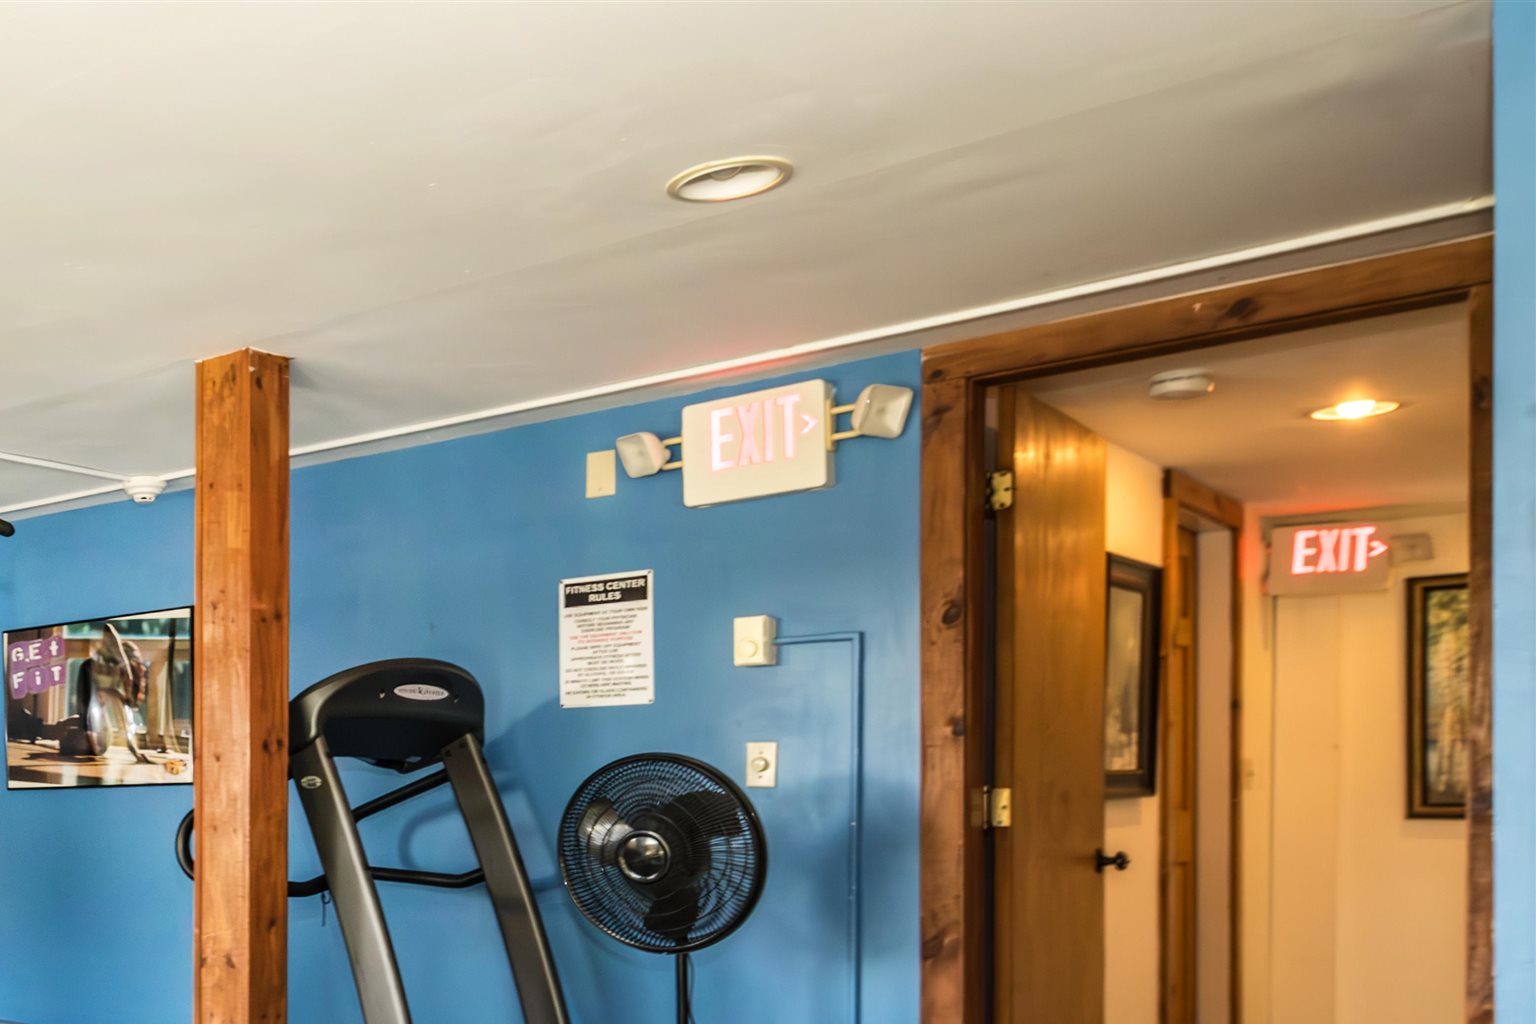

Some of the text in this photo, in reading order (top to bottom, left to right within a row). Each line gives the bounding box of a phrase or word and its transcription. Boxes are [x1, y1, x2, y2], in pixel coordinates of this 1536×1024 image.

[710, 393, 801, 472] EXIT
[1291, 526, 1376, 575] EXIT
[565, 578, 646, 595] FITNESS CENTER
[588, 591, 622, 602] RULES
